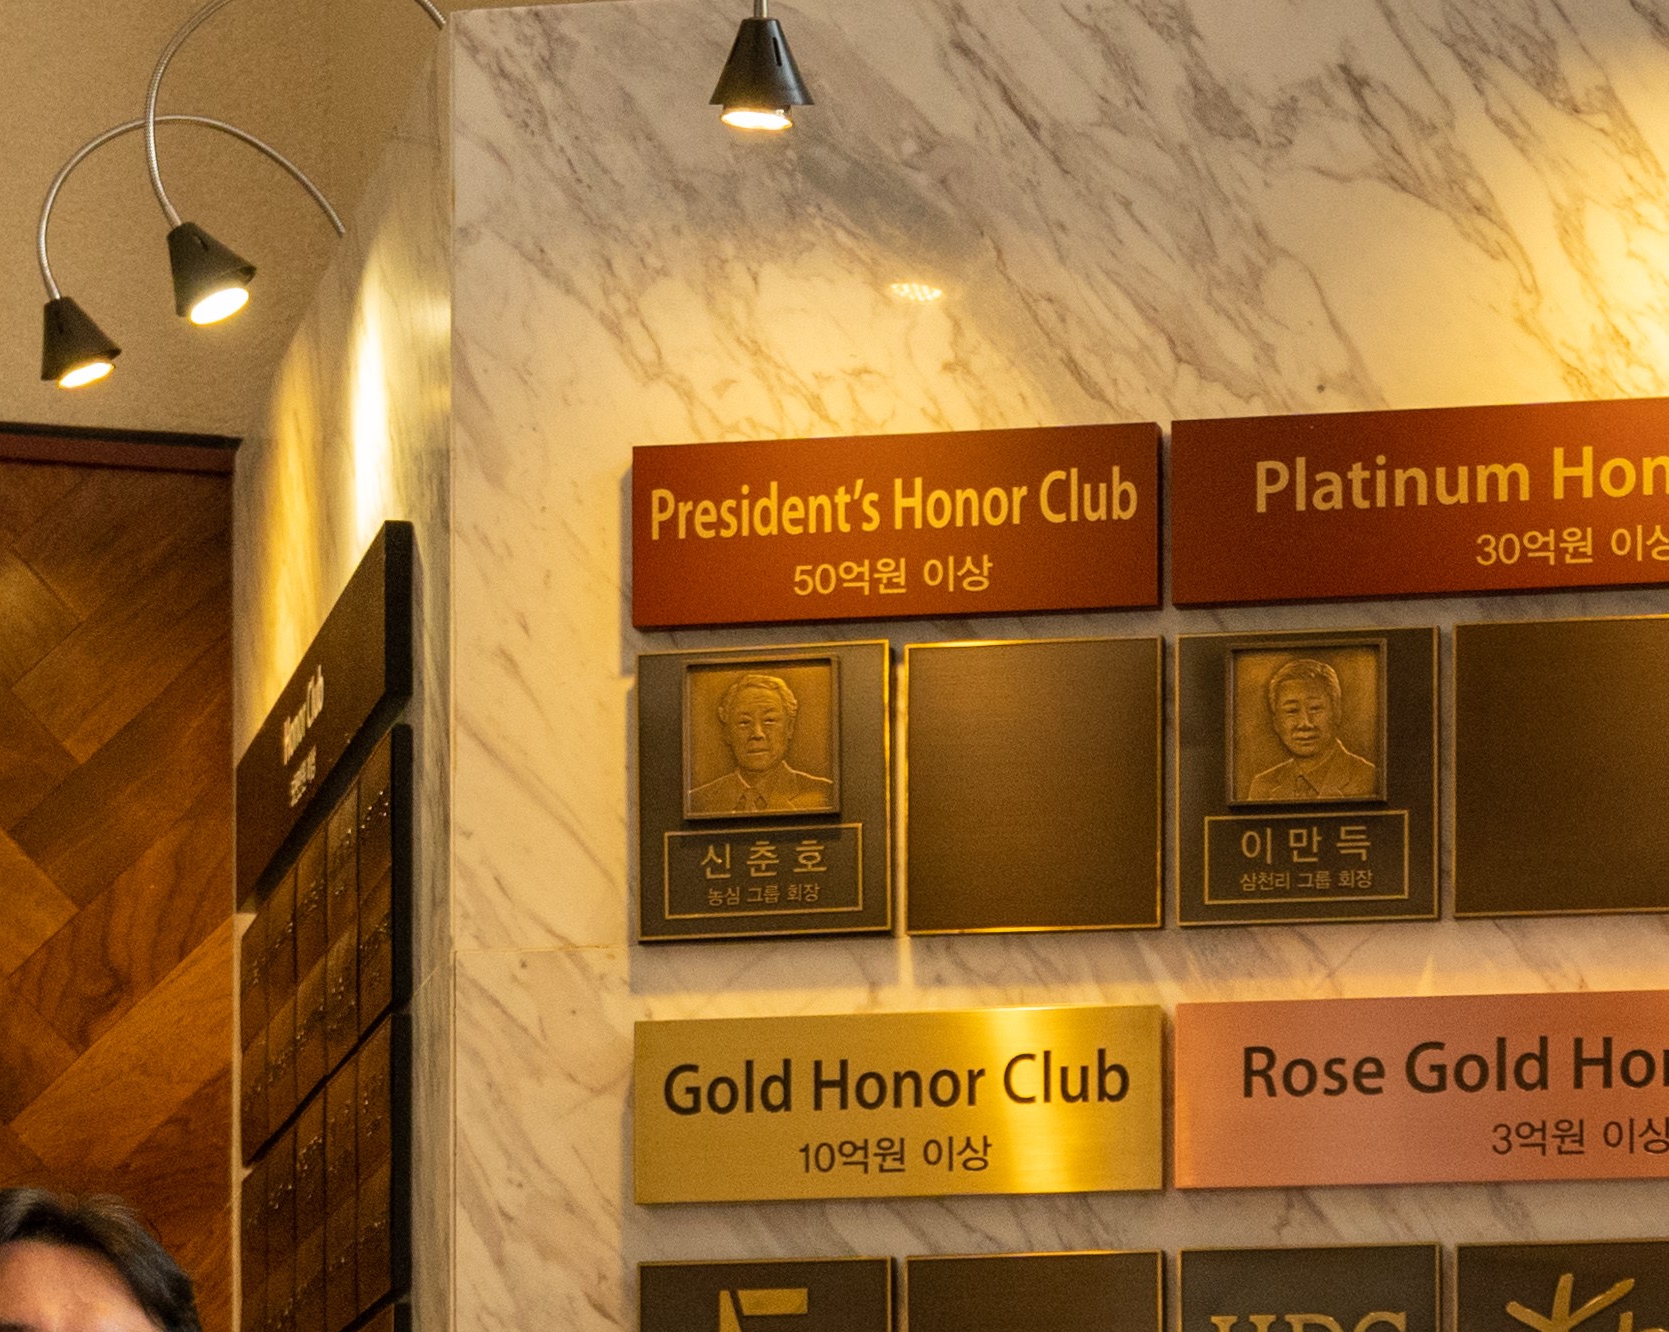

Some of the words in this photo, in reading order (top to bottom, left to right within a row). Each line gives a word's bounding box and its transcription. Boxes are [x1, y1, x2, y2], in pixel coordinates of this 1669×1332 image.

[651, 478, 880, 540] President's
[894, 477, 1027, 530] Honor
[1040, 465, 1138, 523] Club
[1255, 455, 1529, 513] Platinum
[1475, 527, 1593, 565] 30억원
[794, 558, 907, 597] 50억원
[923, 554, 993, 592] 이상
[707, 886, 740, 906] 농심
[746, 885, 780, 904] 그룹
[787, 883, 819, 902] 회장
[1240, 872, 1290, 891] 삼천리
[1297, 871, 1332, 889] 그룹
[1338, 870, 1373, 888] 회장
[663, 1059, 792, 1116] Gold
[812, 1059, 985, 1111] Honor
[1003, 1048, 1130, 1105] Club
[1242, 1046, 1385, 1098] Rose
[1405, 1036, 1549, 1094] Gold
[1572, 1036, 1669, 1089] Ho
[800, 1137, 906, 1174] 10억원
[922, 1136, 992, 1172] 이상
[1492, 1120, 1584, 1156] 3억원
